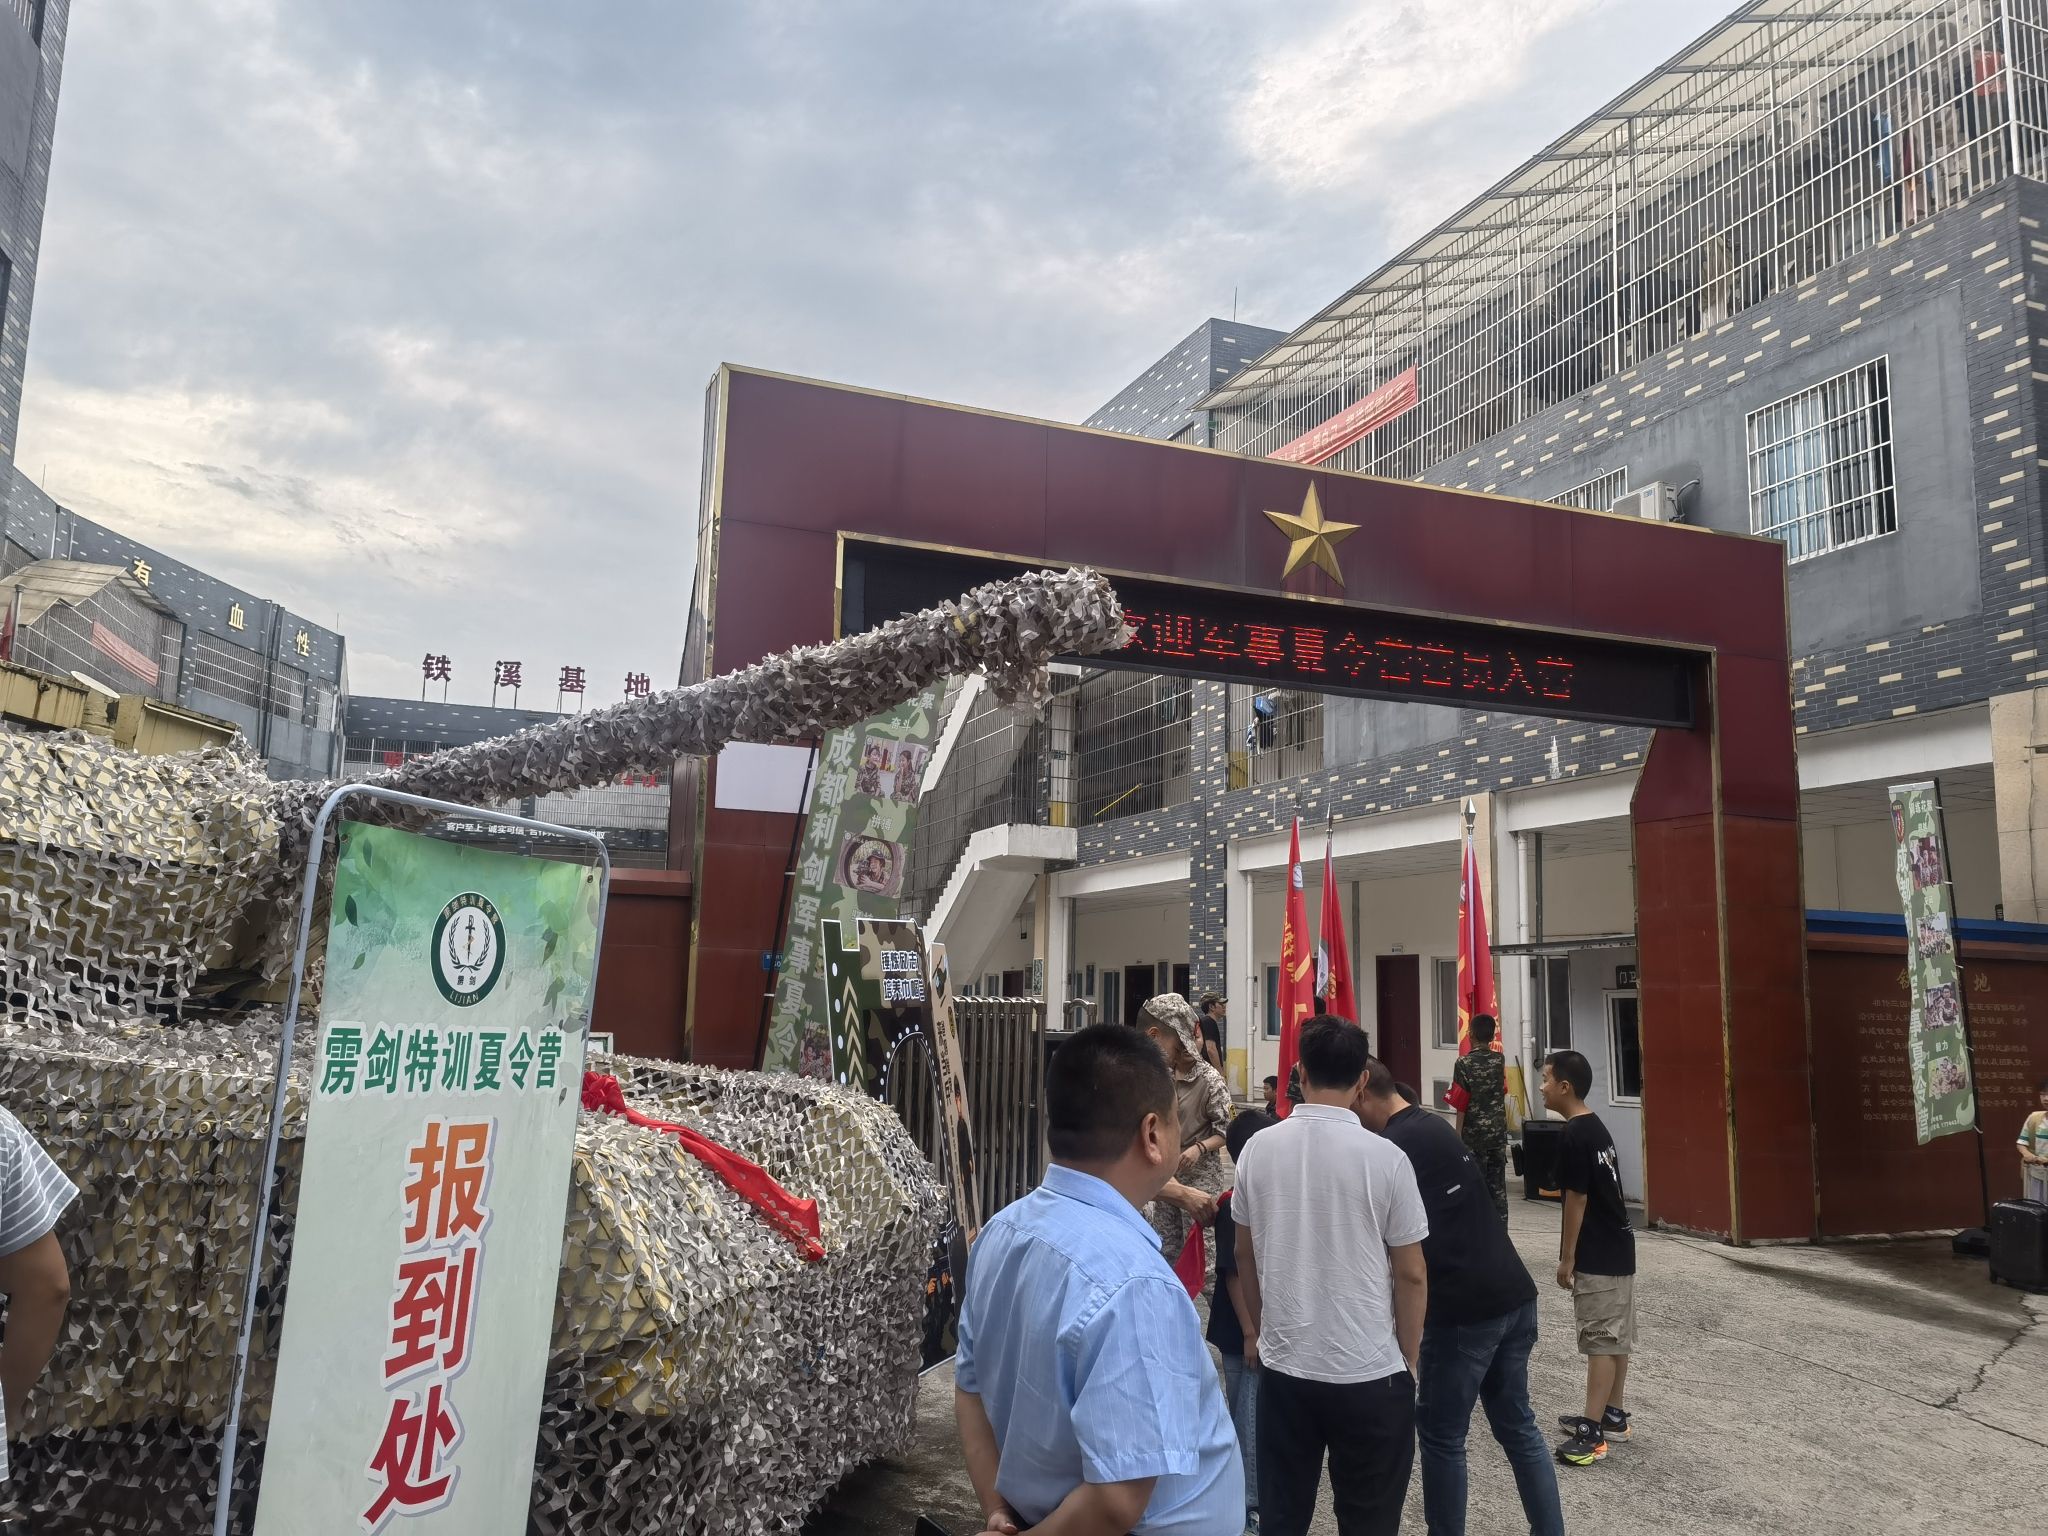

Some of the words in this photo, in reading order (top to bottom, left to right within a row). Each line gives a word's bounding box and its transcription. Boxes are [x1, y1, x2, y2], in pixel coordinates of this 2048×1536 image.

[422, 653, 650, 698] 铁溪基地
[890, 717, 911, 733] 奋斗
[446, 822, 483, 834] 客户至上
[769, 727, 857, 1073] 成都利剑军事夏令
[449, 990, 480, 1005] LIJIAN
[319, 1026, 563, 1096] 雳剑特训夏令营
[363, 1119, 491, 1525] 报到处
